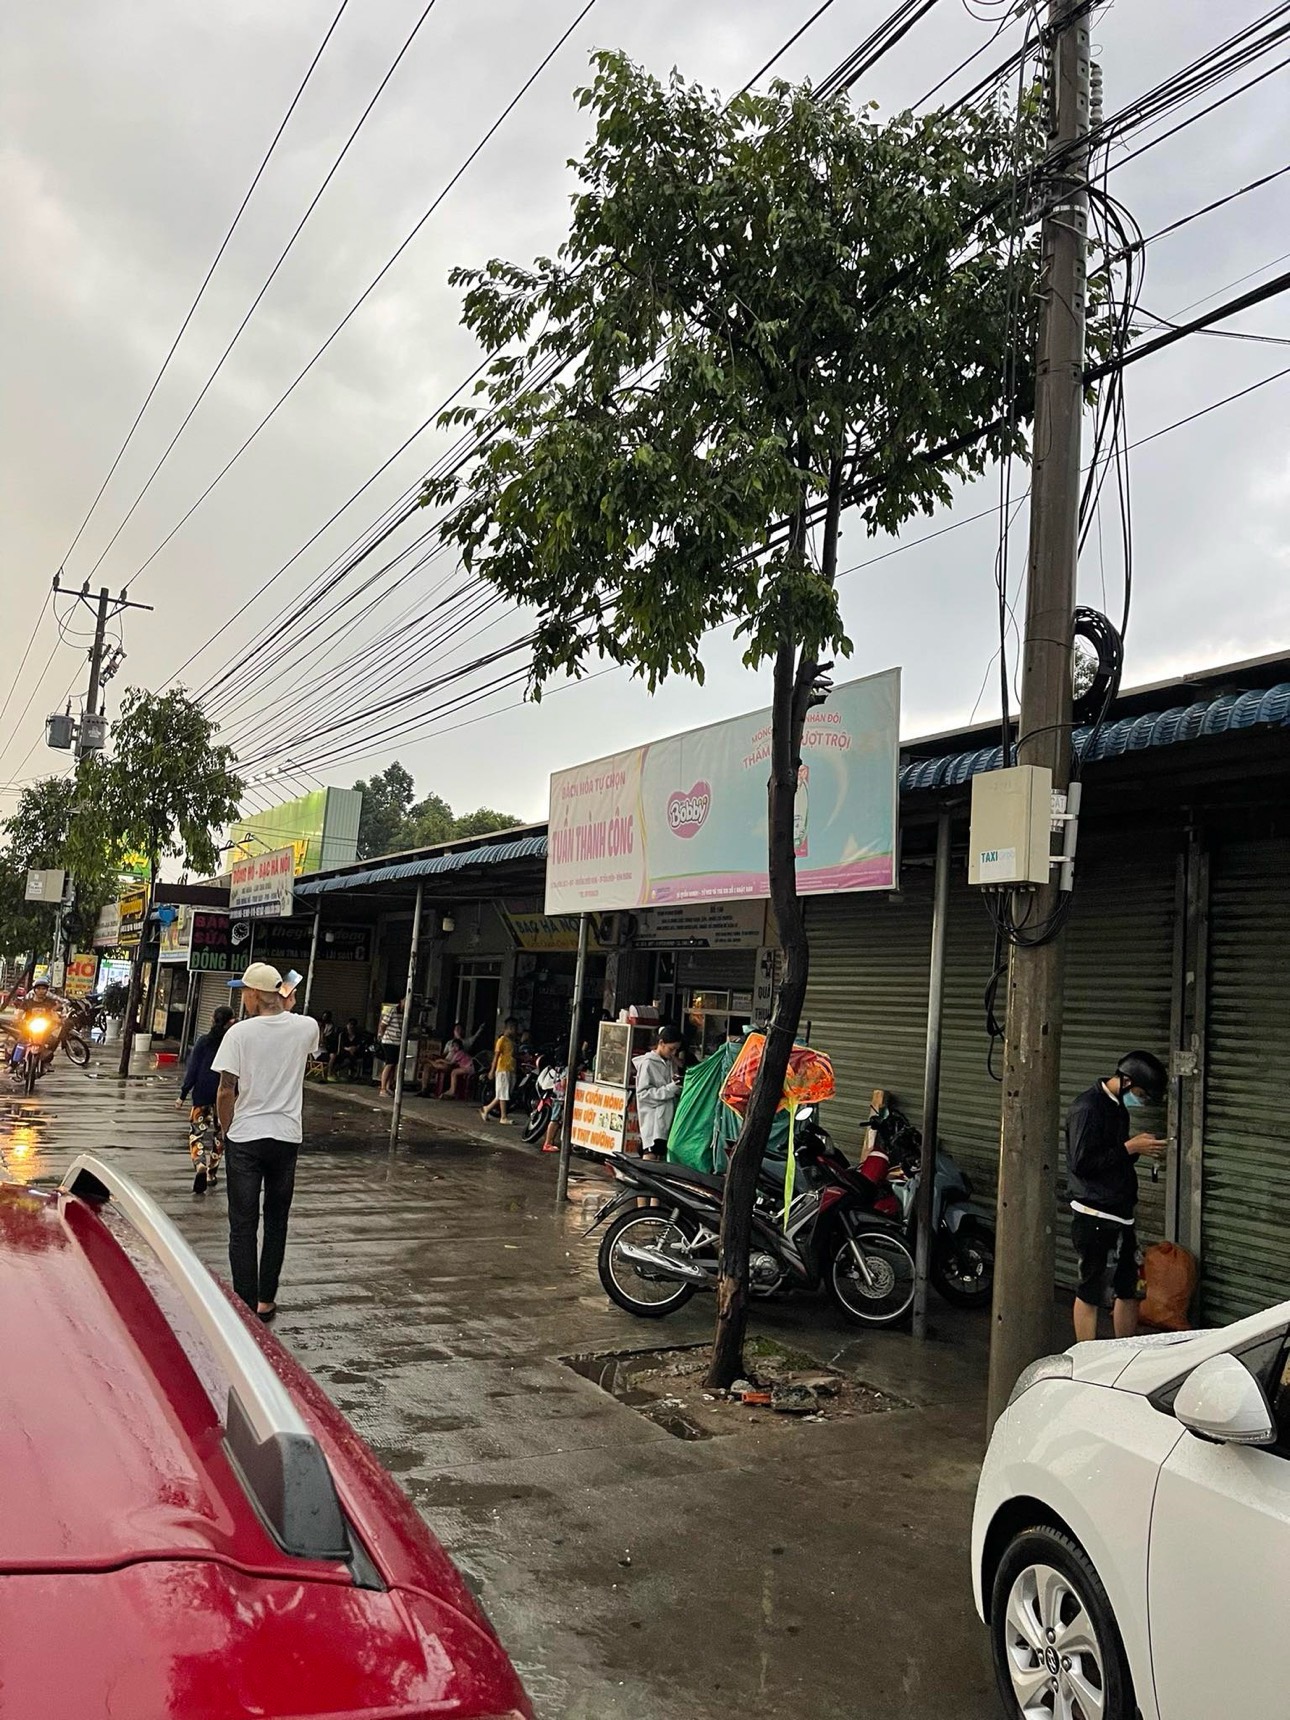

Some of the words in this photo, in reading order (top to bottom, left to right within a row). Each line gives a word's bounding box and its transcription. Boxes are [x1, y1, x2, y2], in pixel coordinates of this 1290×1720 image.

[801, 730, 824, 748] ƯỢT
[825, 731, 851, 751] TRỘI
[606, 771, 626, 790] CHỌN
[670, 794, 710, 830] Bobby
[552, 805, 575, 865] TUẤN
[576, 810, 606, 862] THÀNH
[607, 806, 634, 858] CÔNG
[981, 851, 998, 863] TAXI
[190, 946, 228, 970] ĐỒNG
